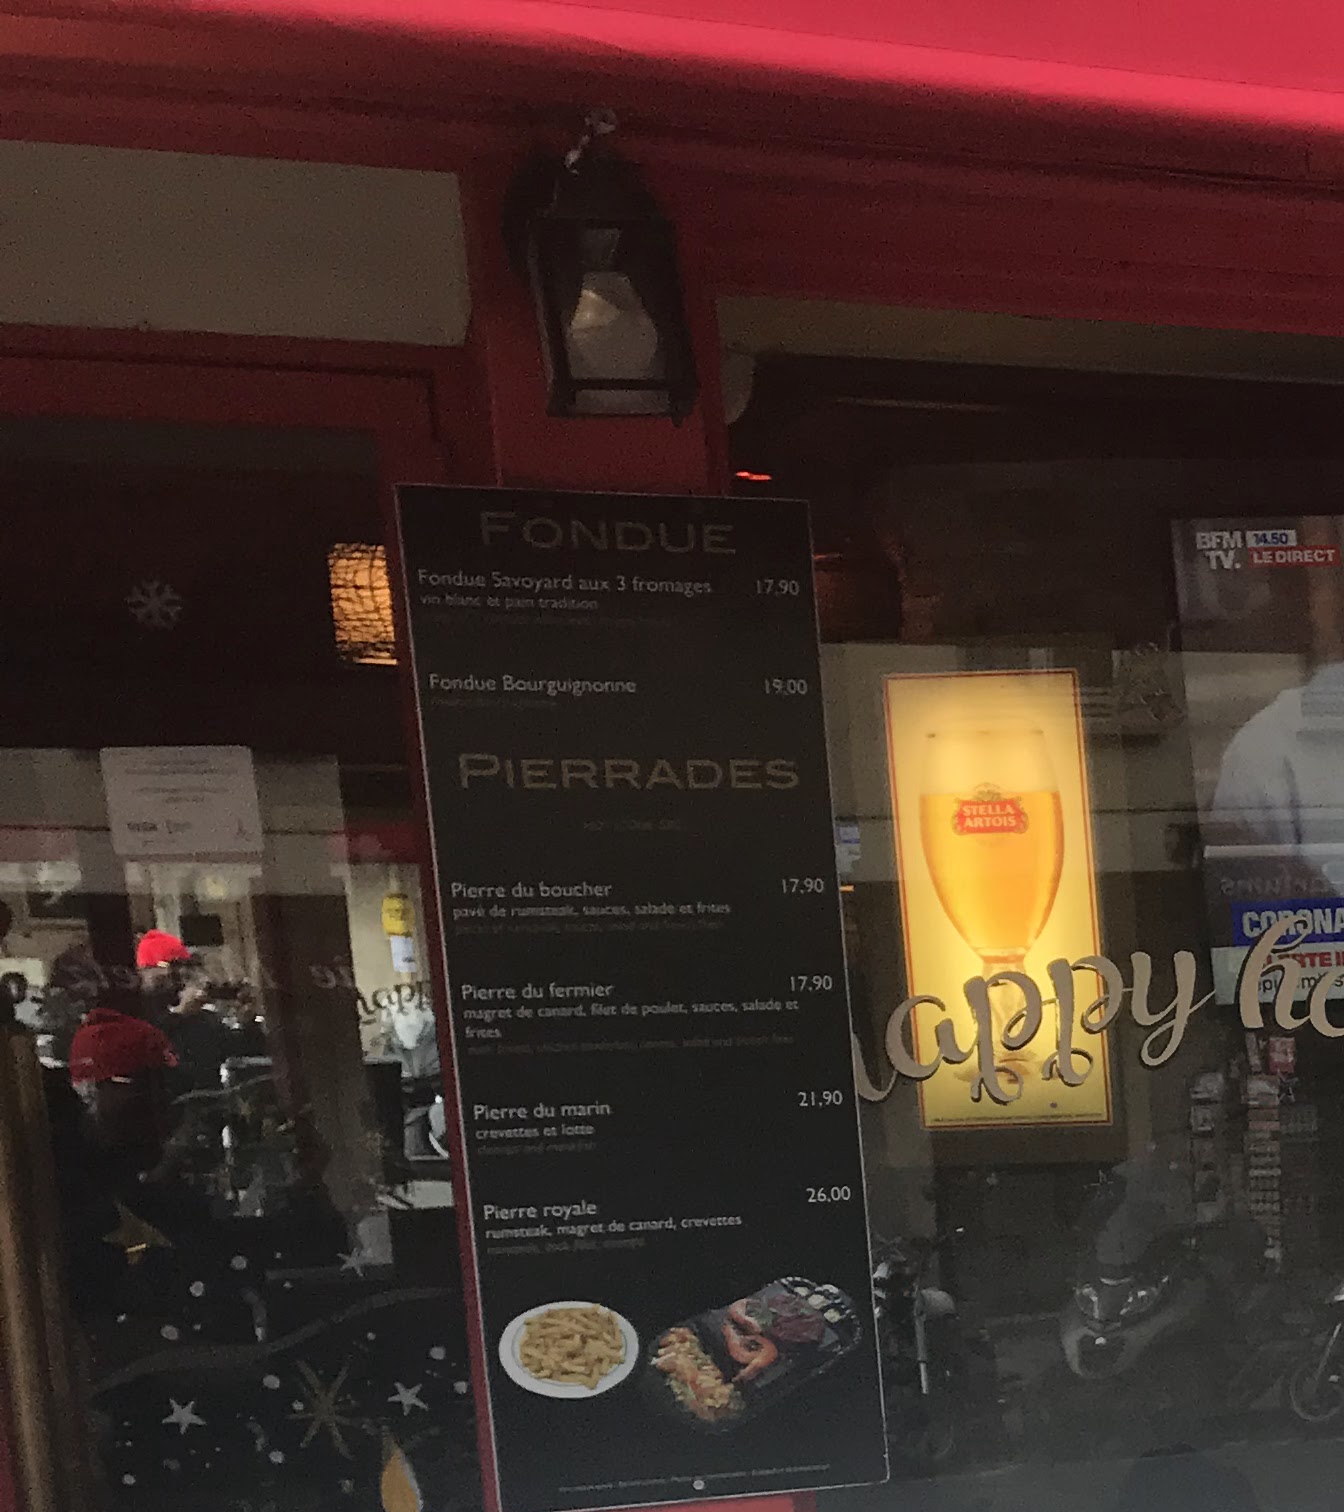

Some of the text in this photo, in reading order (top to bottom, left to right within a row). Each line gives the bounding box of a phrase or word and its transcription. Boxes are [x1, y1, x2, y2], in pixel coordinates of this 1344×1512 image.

[479, 511, 737, 555] FONDUE
[1196, 532, 1242, 549] BFM
[1253, 550, 1335, 563] LE DIRECT
[417, 570, 712, 595] Fondue Savoyard aux 3 fromages
[429, 674, 637, 696] Fondue Bourguignonne
[457, 753, 799, 790] PIERRADES
[961, 803, 1016, 817] STELLA
[962, 814, 1017, 829] ARTOIS
[452, 881, 612, 899] Pierre du boucher
[461, 981, 615, 1001] Pierre du fermier
[853, 949, 1215, 1105] appy
[473, 1101, 611, 1120] Pierre du marin
[483, 1200, 597, 1220] Pierre royale
